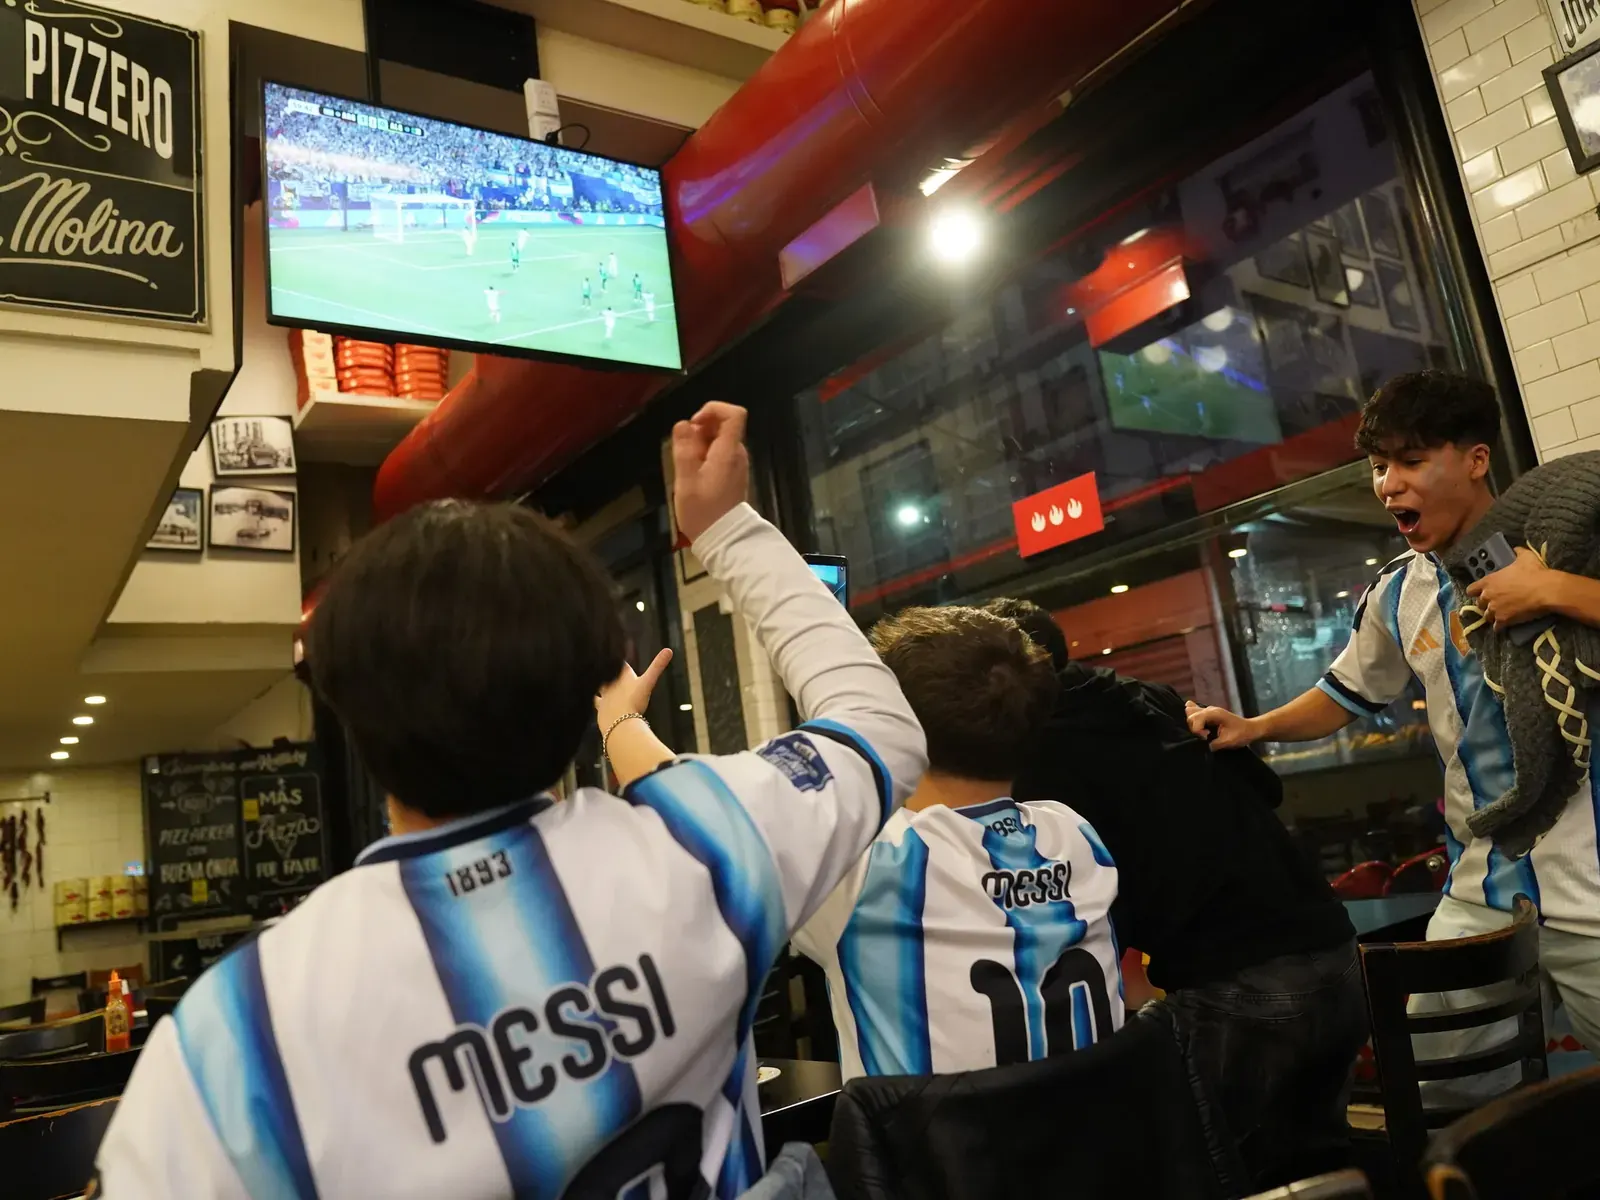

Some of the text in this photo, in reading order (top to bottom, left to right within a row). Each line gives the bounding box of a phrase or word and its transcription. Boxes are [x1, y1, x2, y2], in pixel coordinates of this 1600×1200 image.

[1560, 0, 1600, 48] JOR
[25, 18, 173, 160] PIZZERO
[0, 172, 184, 258] Molina
[444, 850, 515, 897] 1893
[981, 860, 1073, 909] MESSI
[408, 952, 676, 1144] MESSI
[970, 948, 1115, 1066] 10
